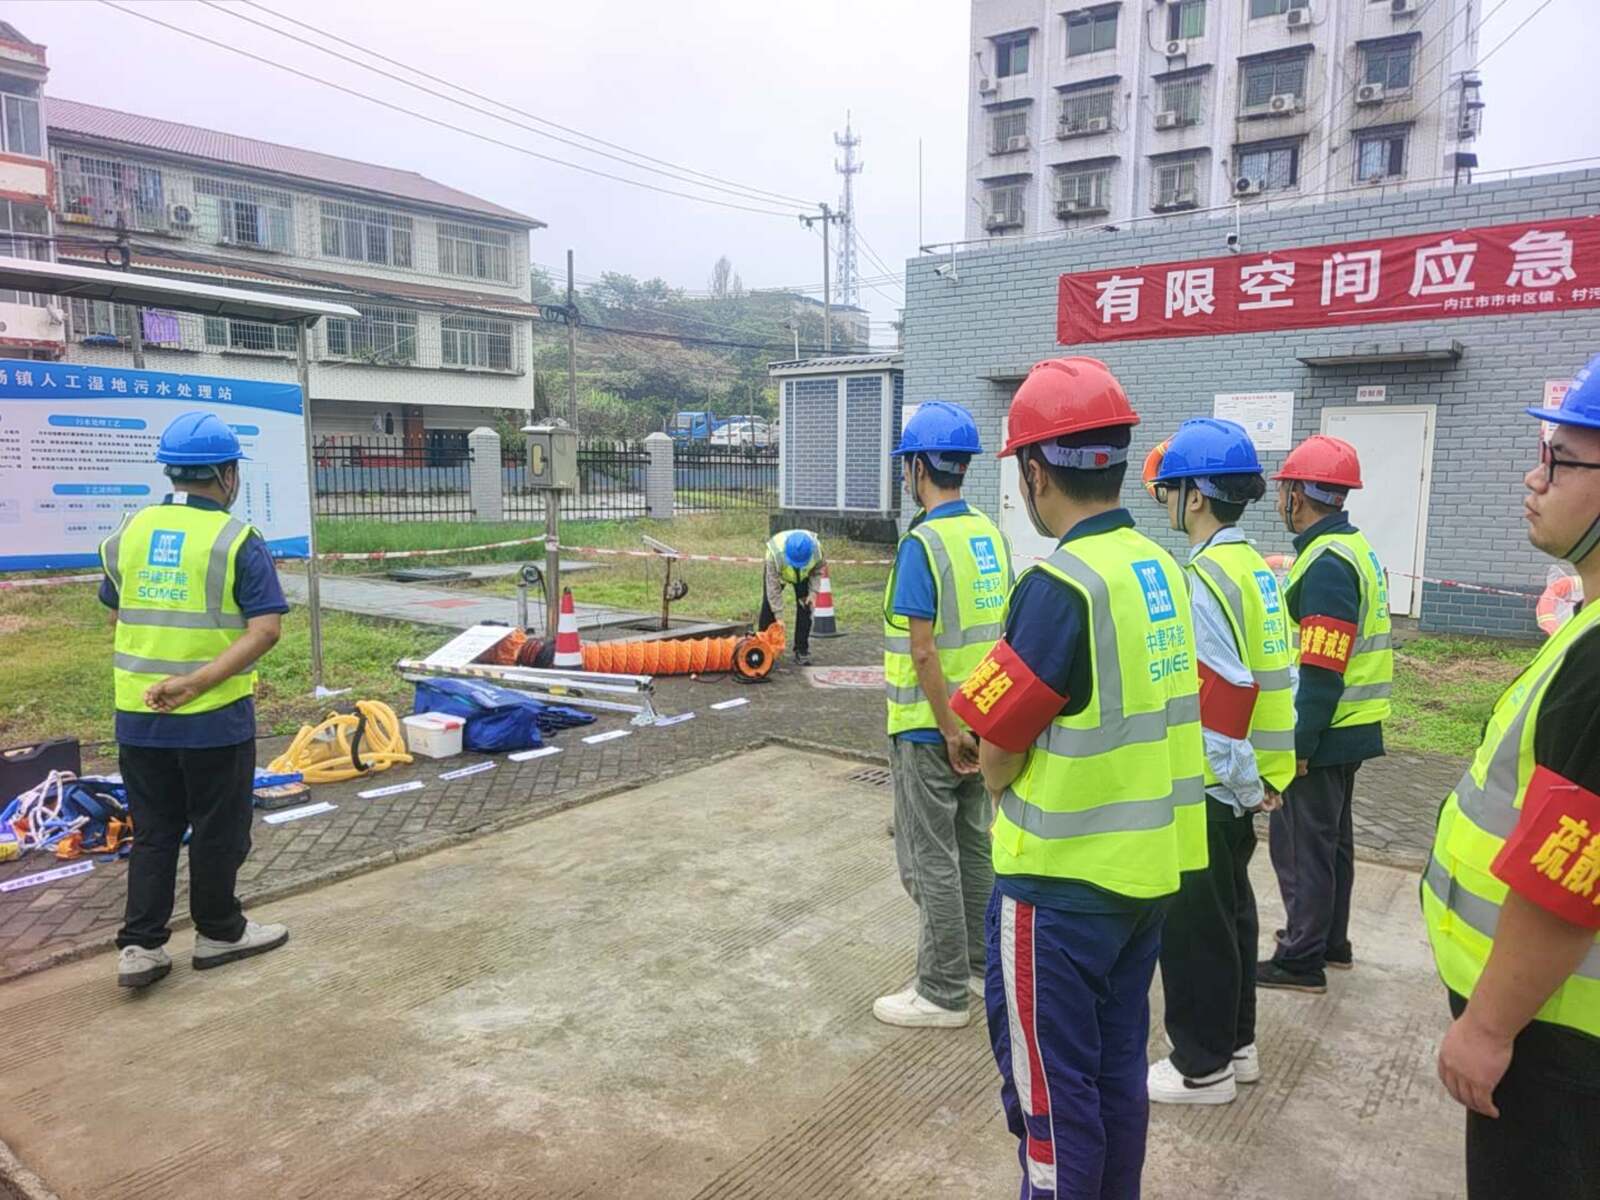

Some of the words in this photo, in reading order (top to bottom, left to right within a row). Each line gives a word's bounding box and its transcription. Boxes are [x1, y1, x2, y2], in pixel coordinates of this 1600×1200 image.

[1095, 229, 1577, 324] 有限空间应急
[138, 569, 188, 586] 中建环能
[1146, 624, 1186, 655] 中建环能
[1530, 814, 1600, 905] 疏散
